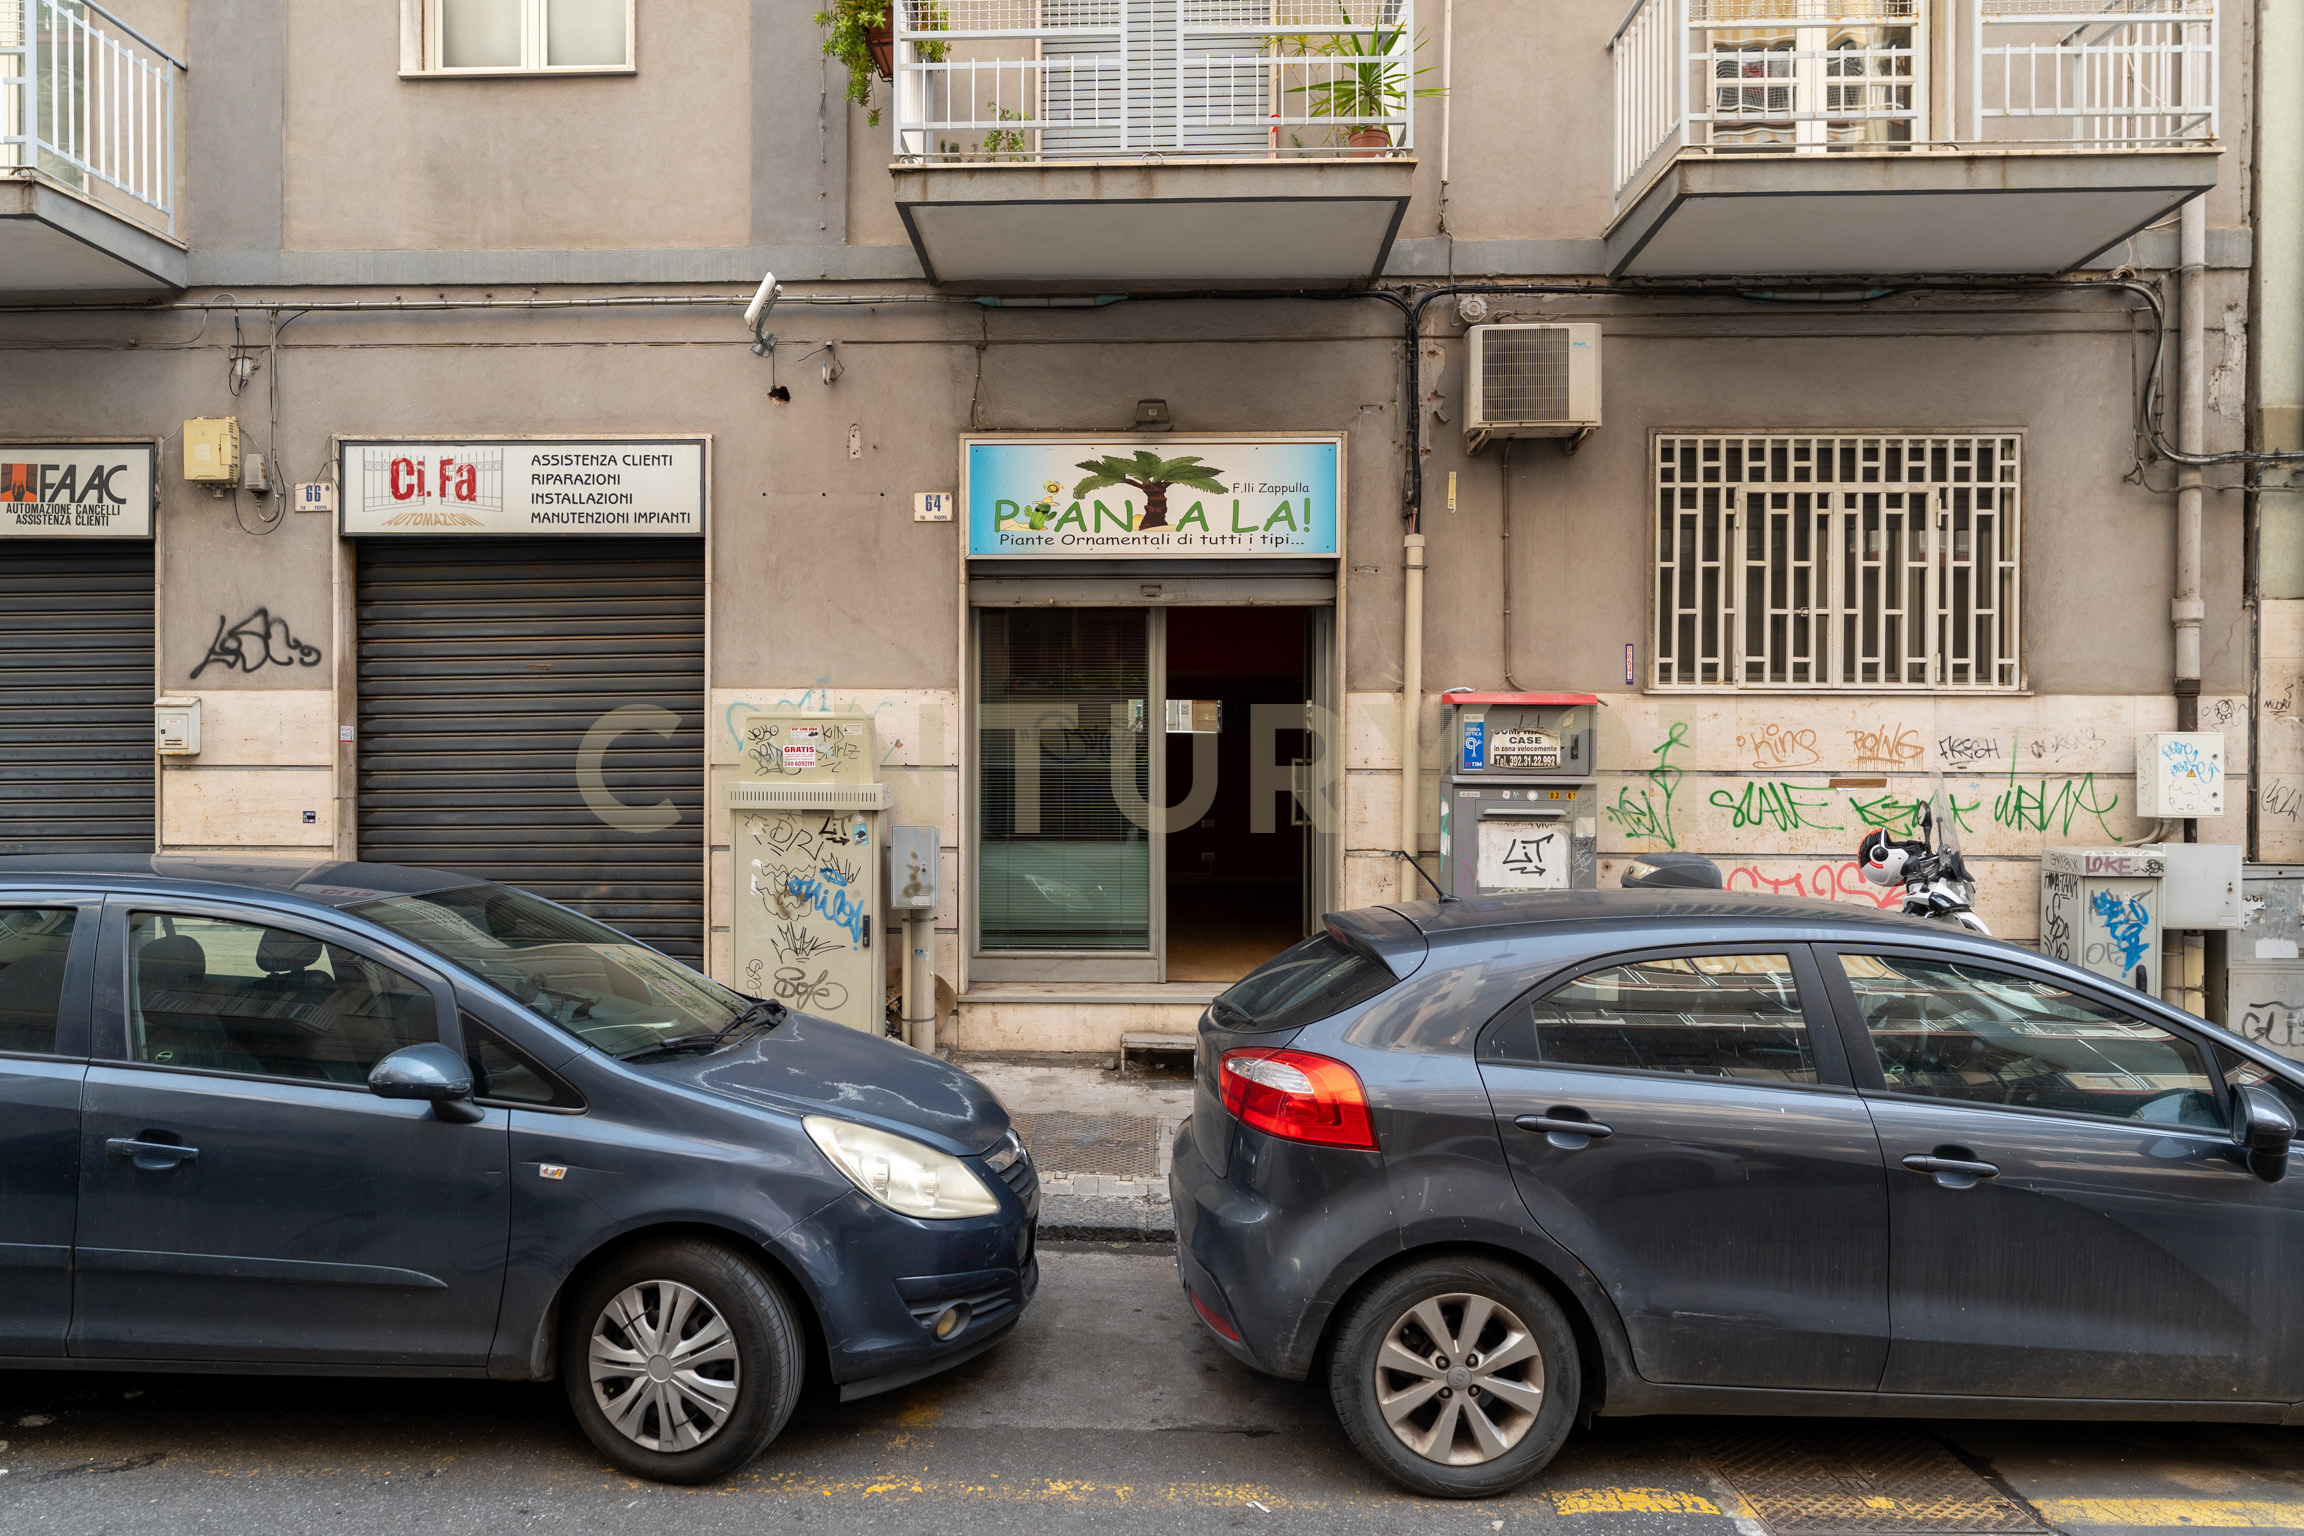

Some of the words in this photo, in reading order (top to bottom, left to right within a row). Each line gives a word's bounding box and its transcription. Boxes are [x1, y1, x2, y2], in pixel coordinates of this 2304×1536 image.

[531, 454, 618, 466] ASSISTENZA
[622, 454, 673, 466] CLIENTI
[39, 464, 128, 504] FAAC
[531, 473, 621, 485] RIPARAZIONI
[306, 485, 321, 502] 66
[1232, 482, 1254, 493] F.lli
[1258, 482, 1310, 495] Zappulla
[531, 493, 633, 504] INSTALLAZIONI
[925, 494, 942, 512] 64
[6, 503, 72, 515] AUTOMAZIONE
[75, 504, 121, 516] CANCELLI
[15, 514, 72, 526] ASSISTENZA
[75, 515, 109, 527] CLIENTI
[380, 512, 485, 527] AUTOMAZIONI
[530, 512, 629, 524] MANUTENZIONI
[634, 512, 691, 524] IMPIANTI
[1000, 534, 1055, 546] Piante
[1061, 533, 1171, 546] Ornamentali
[1177, 533, 1193, 545] di
[1200, 533, 1242, 545] tutti
[1248, 534, 1254, 545] i
[1260, 534, 1305, 548] tipi...
[1509, 736, 1542, 744] CASE
[1495, 755, 1508, 766] Tel.
[1509, 755, 1556, 767] 392.31.22.992
